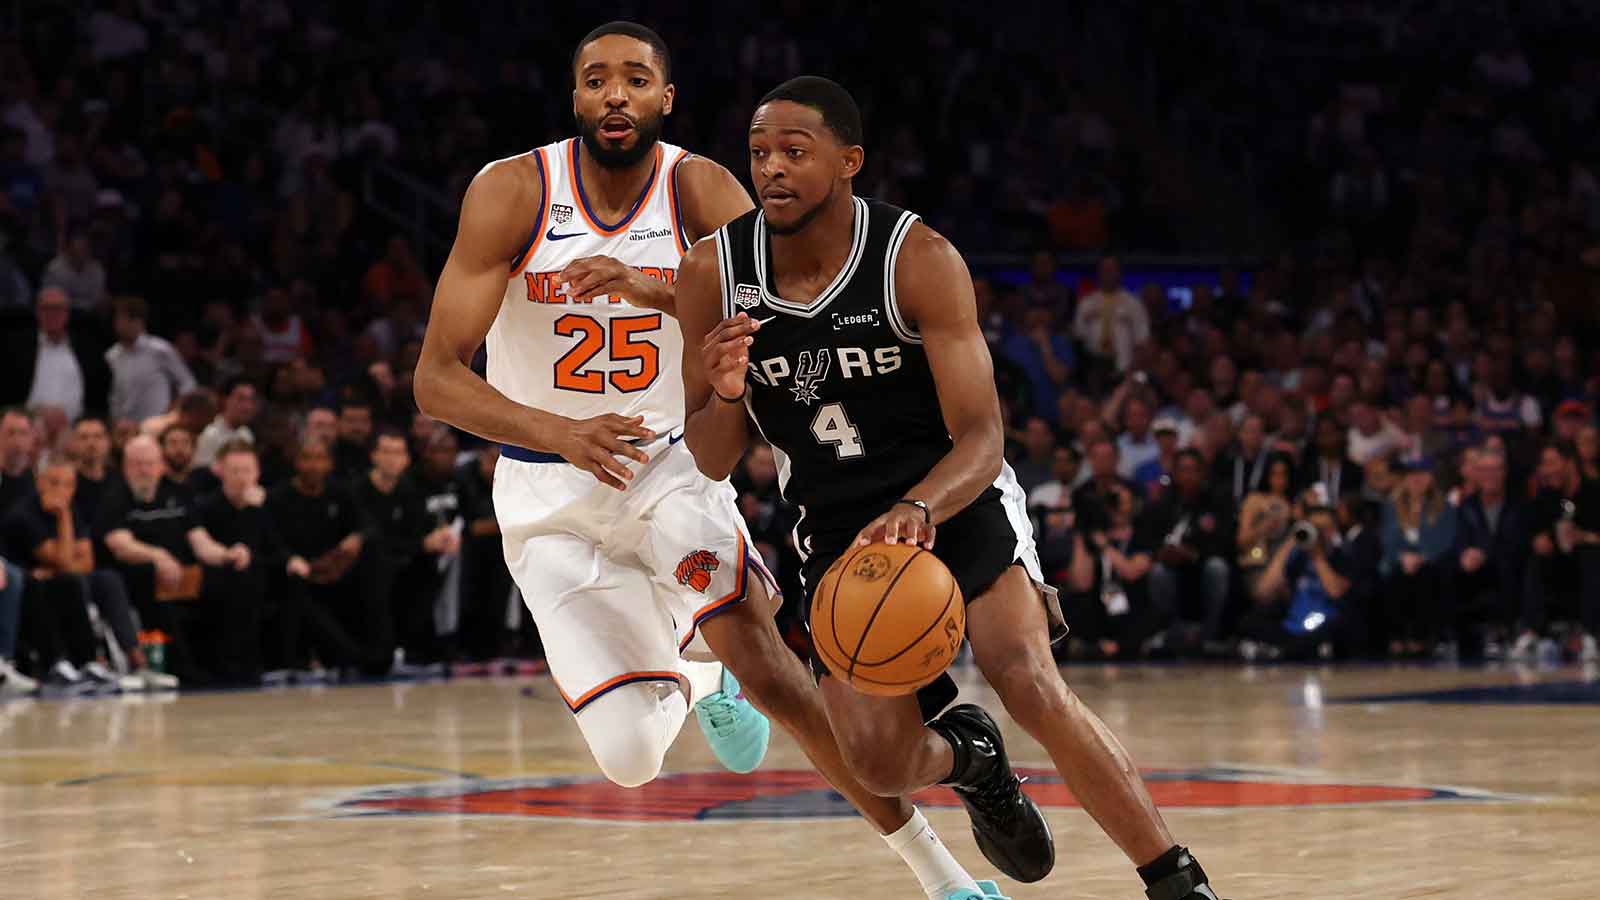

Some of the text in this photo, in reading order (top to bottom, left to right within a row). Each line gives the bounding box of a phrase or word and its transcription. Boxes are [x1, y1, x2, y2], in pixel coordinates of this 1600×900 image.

[629, 233, 646, 241] abu
[646, 228, 672, 239] dhabi
[739, 287, 758, 295] USA
[838, 314, 873, 326] LEDGER
[554, 313, 662, 394] 25
[810, 402, 866, 460] 4
